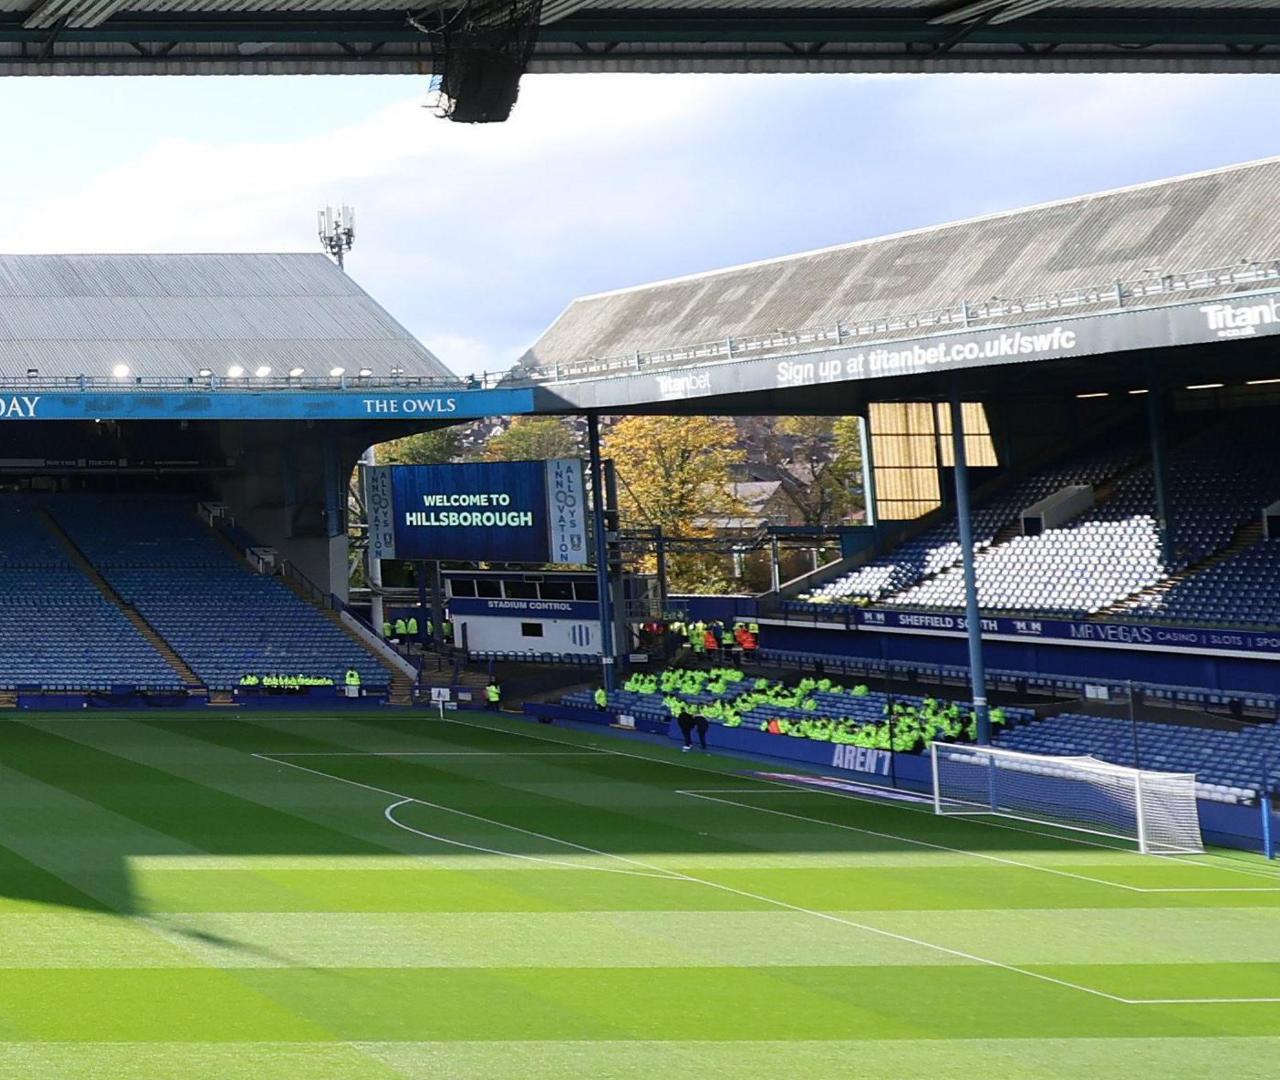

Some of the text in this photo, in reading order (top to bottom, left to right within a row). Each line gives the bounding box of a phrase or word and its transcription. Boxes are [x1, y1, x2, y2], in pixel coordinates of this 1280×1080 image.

[777, 326, 1077, 383] Sign up at titanbet.co.uk/swfc
[362, 398, 456, 413] THE OWLS
[379, 472, 389, 528] ALLOYS
[423, 493, 510, 507] WELCOME TO
[565, 465, 577, 529] ALLOYS
[372, 467, 383, 557] INNOVATION
[405, 511, 533, 527] HILLSBOROUGH
[555, 461, 569, 562] INNOVATION
[487, 600, 573, 611] STADIUM CONTROL
[898, 613, 954, 628] SHEFFIELD
[957, 617, 998, 631] STH
[1070, 624, 1094, 640] MR
[1096, 624, 1153, 643] VEGAS
[1156, 631, 1198, 643] CASINO
[1210, 634, 1243, 646] SLOTS
